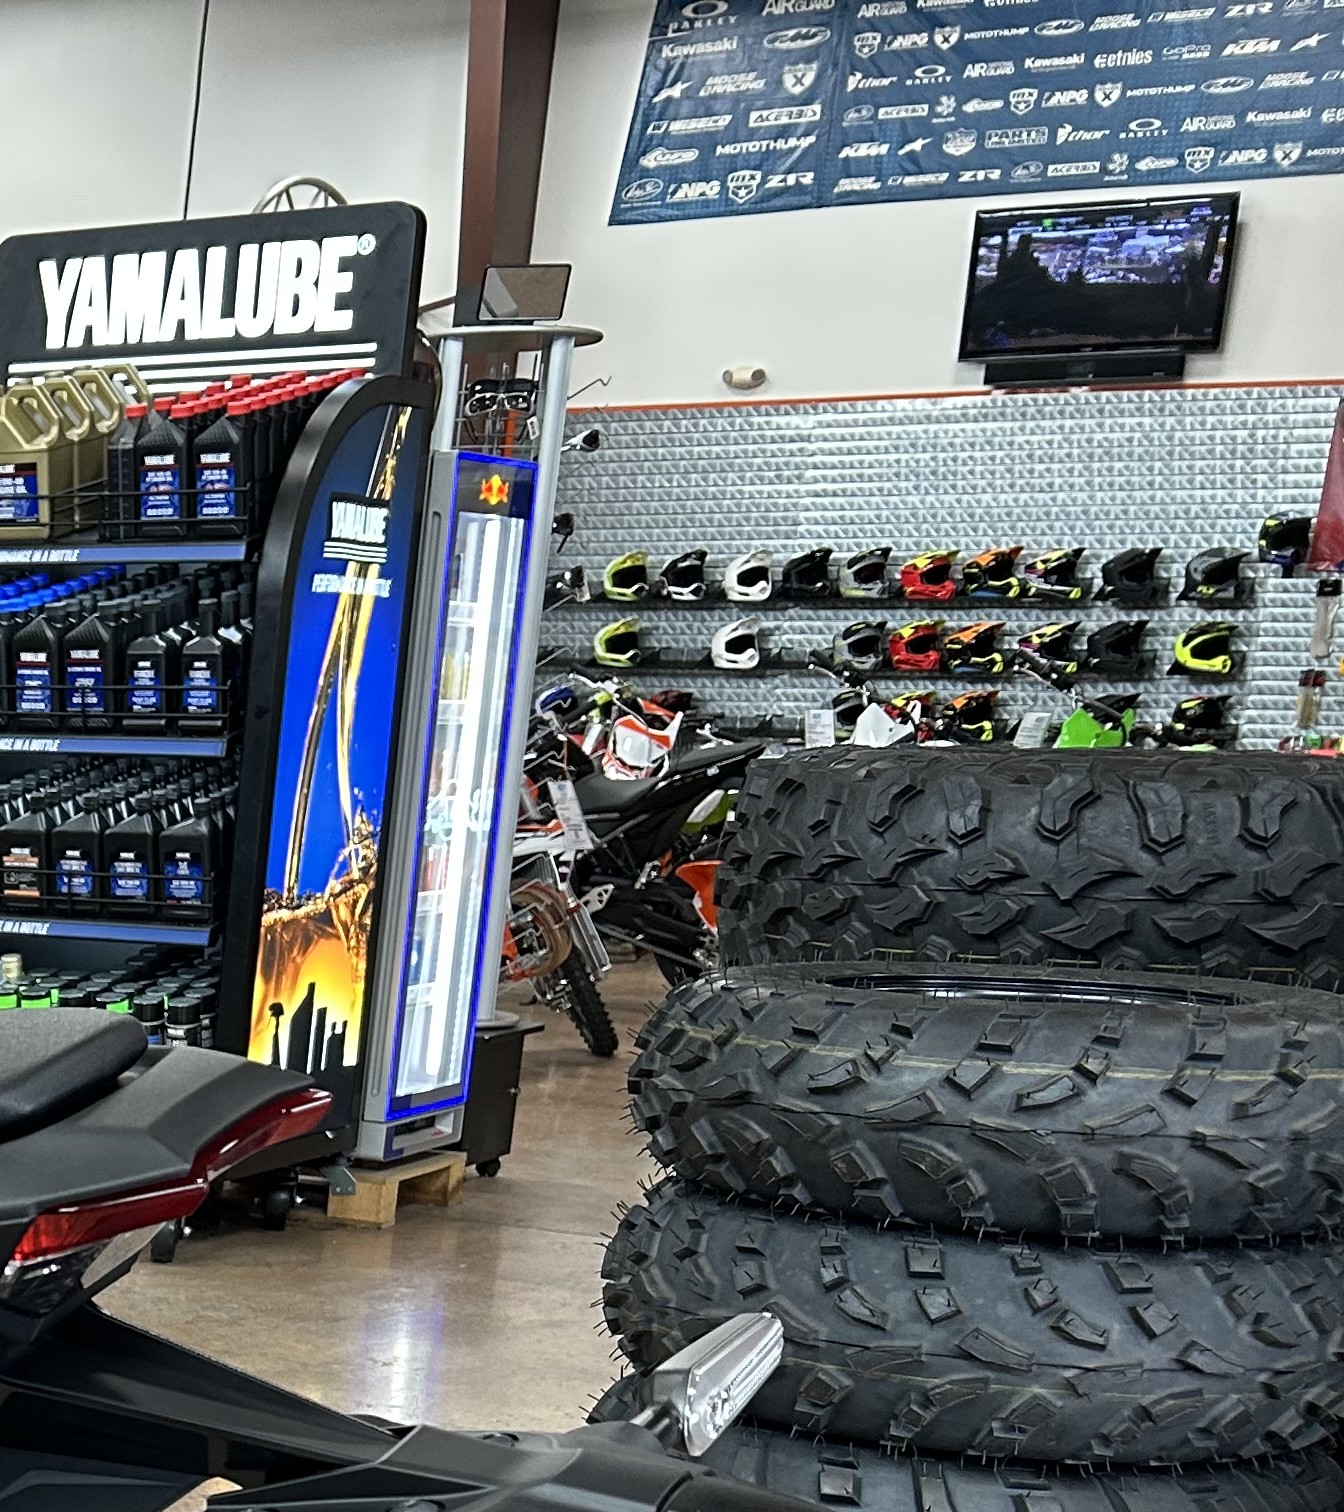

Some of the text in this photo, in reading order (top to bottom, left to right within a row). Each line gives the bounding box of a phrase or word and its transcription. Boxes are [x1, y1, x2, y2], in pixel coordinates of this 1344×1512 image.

[964, 27, 1029, 40] MOTOTHUMP
[661, 36, 738, 58] Kawasaki
[1221, 38, 1280, 57] KTM
[1024, 53, 1085, 69] Kawasaki
[963, 64, 986, 78] AIR
[1126, 84, 1195, 98] MOTOTHUMP
[754, 108, 817, 125] ACERBIS
[1246, 107, 1312, 123] Kawasaki
[1181, 117, 1206, 132] AIR
[716, 135, 816, 156] MOTOTHUMP
[839, 142, 889, 158] KTM
